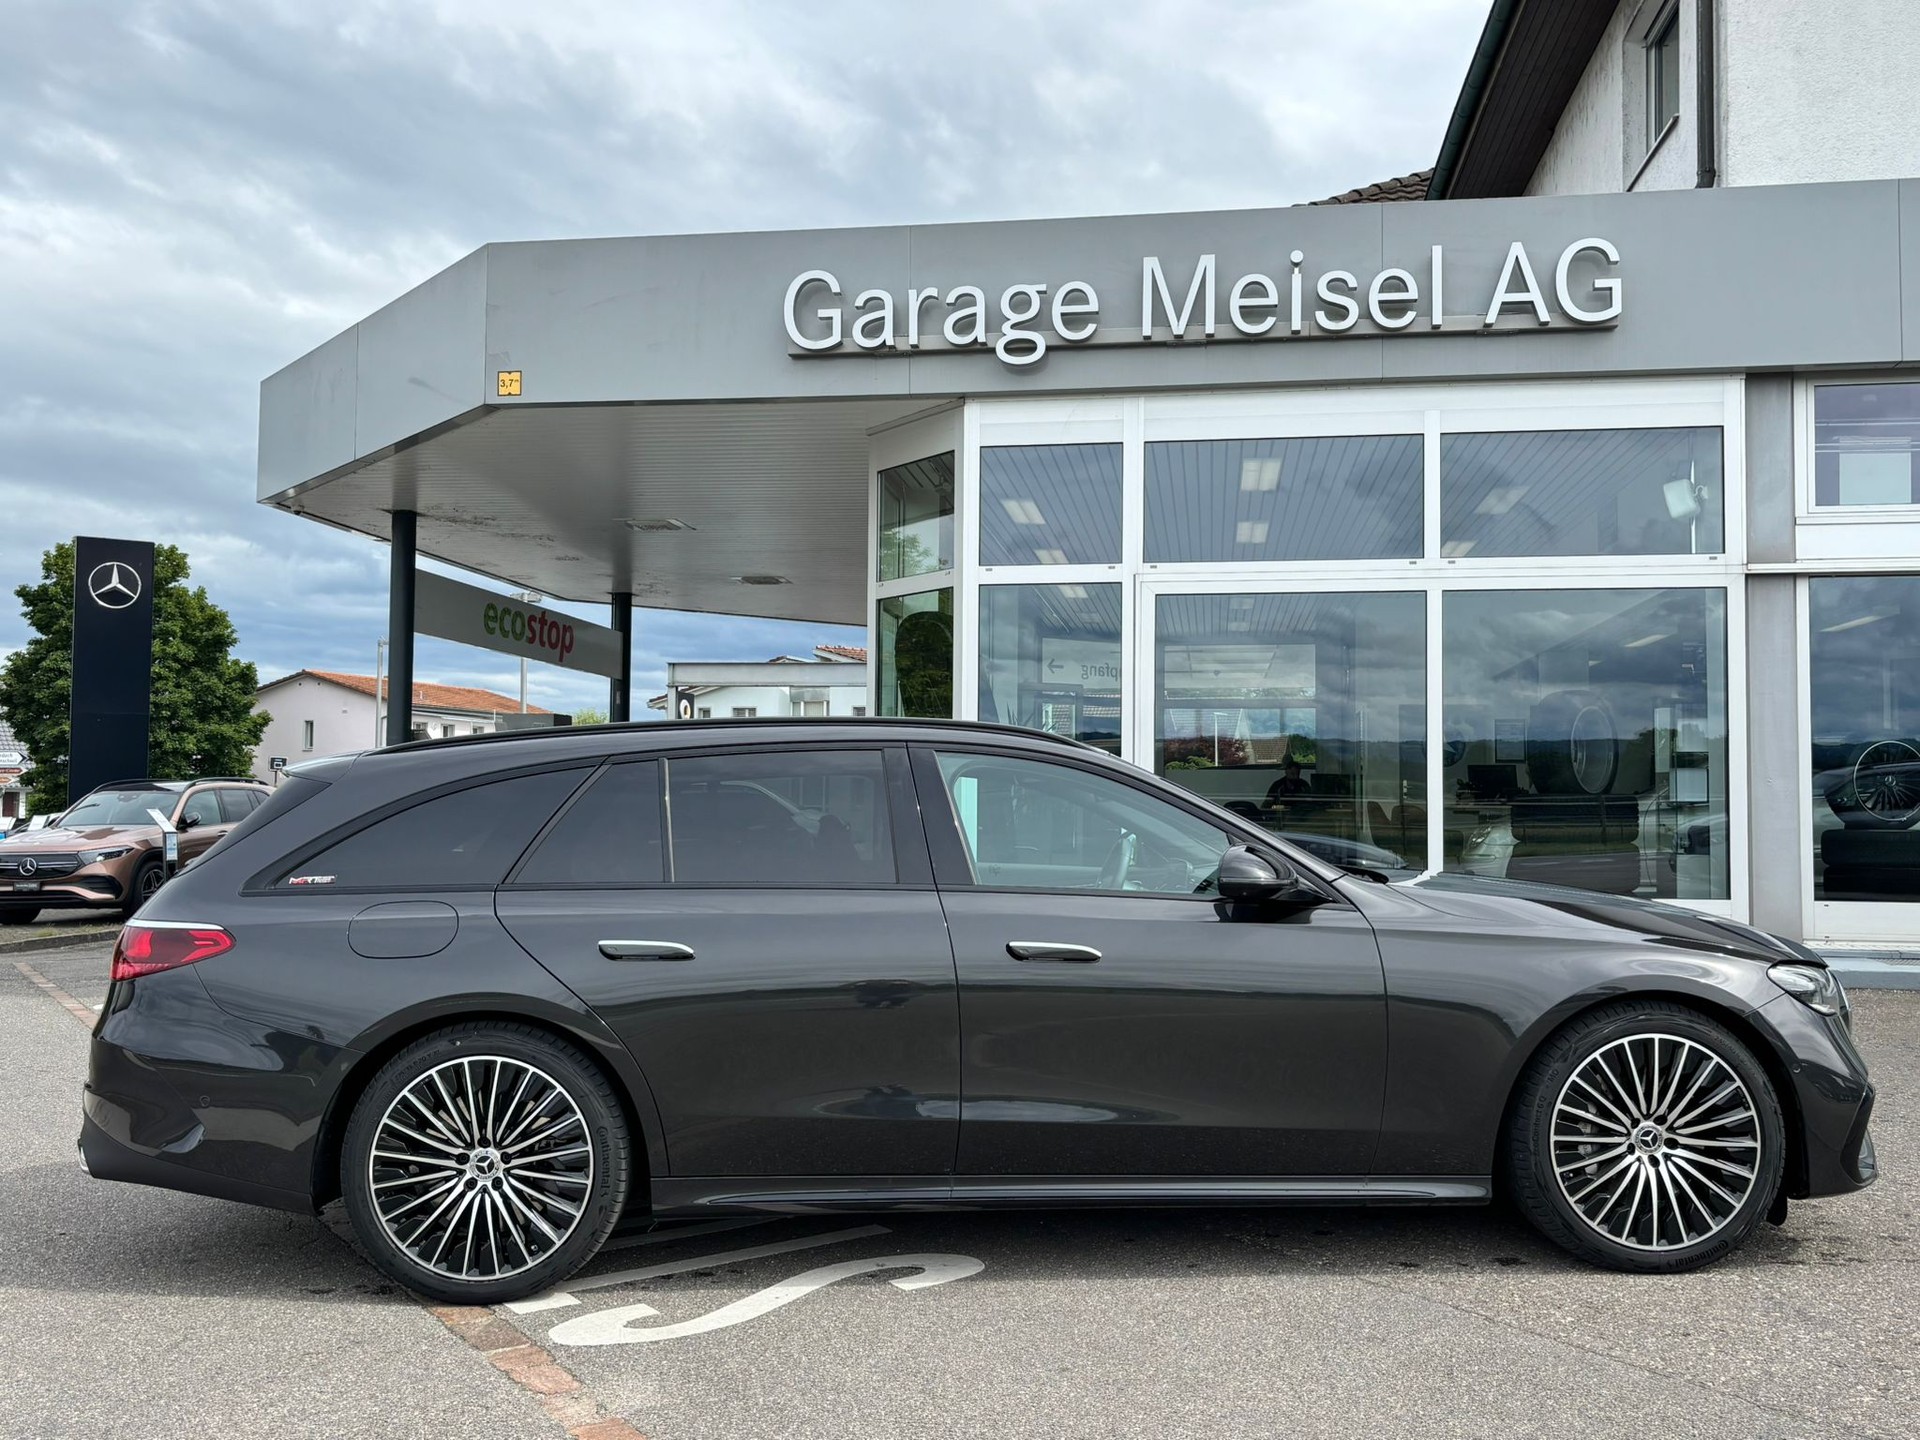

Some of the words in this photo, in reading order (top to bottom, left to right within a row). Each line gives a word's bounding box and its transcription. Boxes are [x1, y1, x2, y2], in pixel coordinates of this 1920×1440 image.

[784, 269, 1099, 365] Garage
[1141, 244, 1443, 340] Meisel
[1482, 237, 1623, 328] AG
[484, 602, 574, 663] ecostop
[596, 1126, 611, 1189] Continental
[1675, 1239, 1729, 1268] Continental
